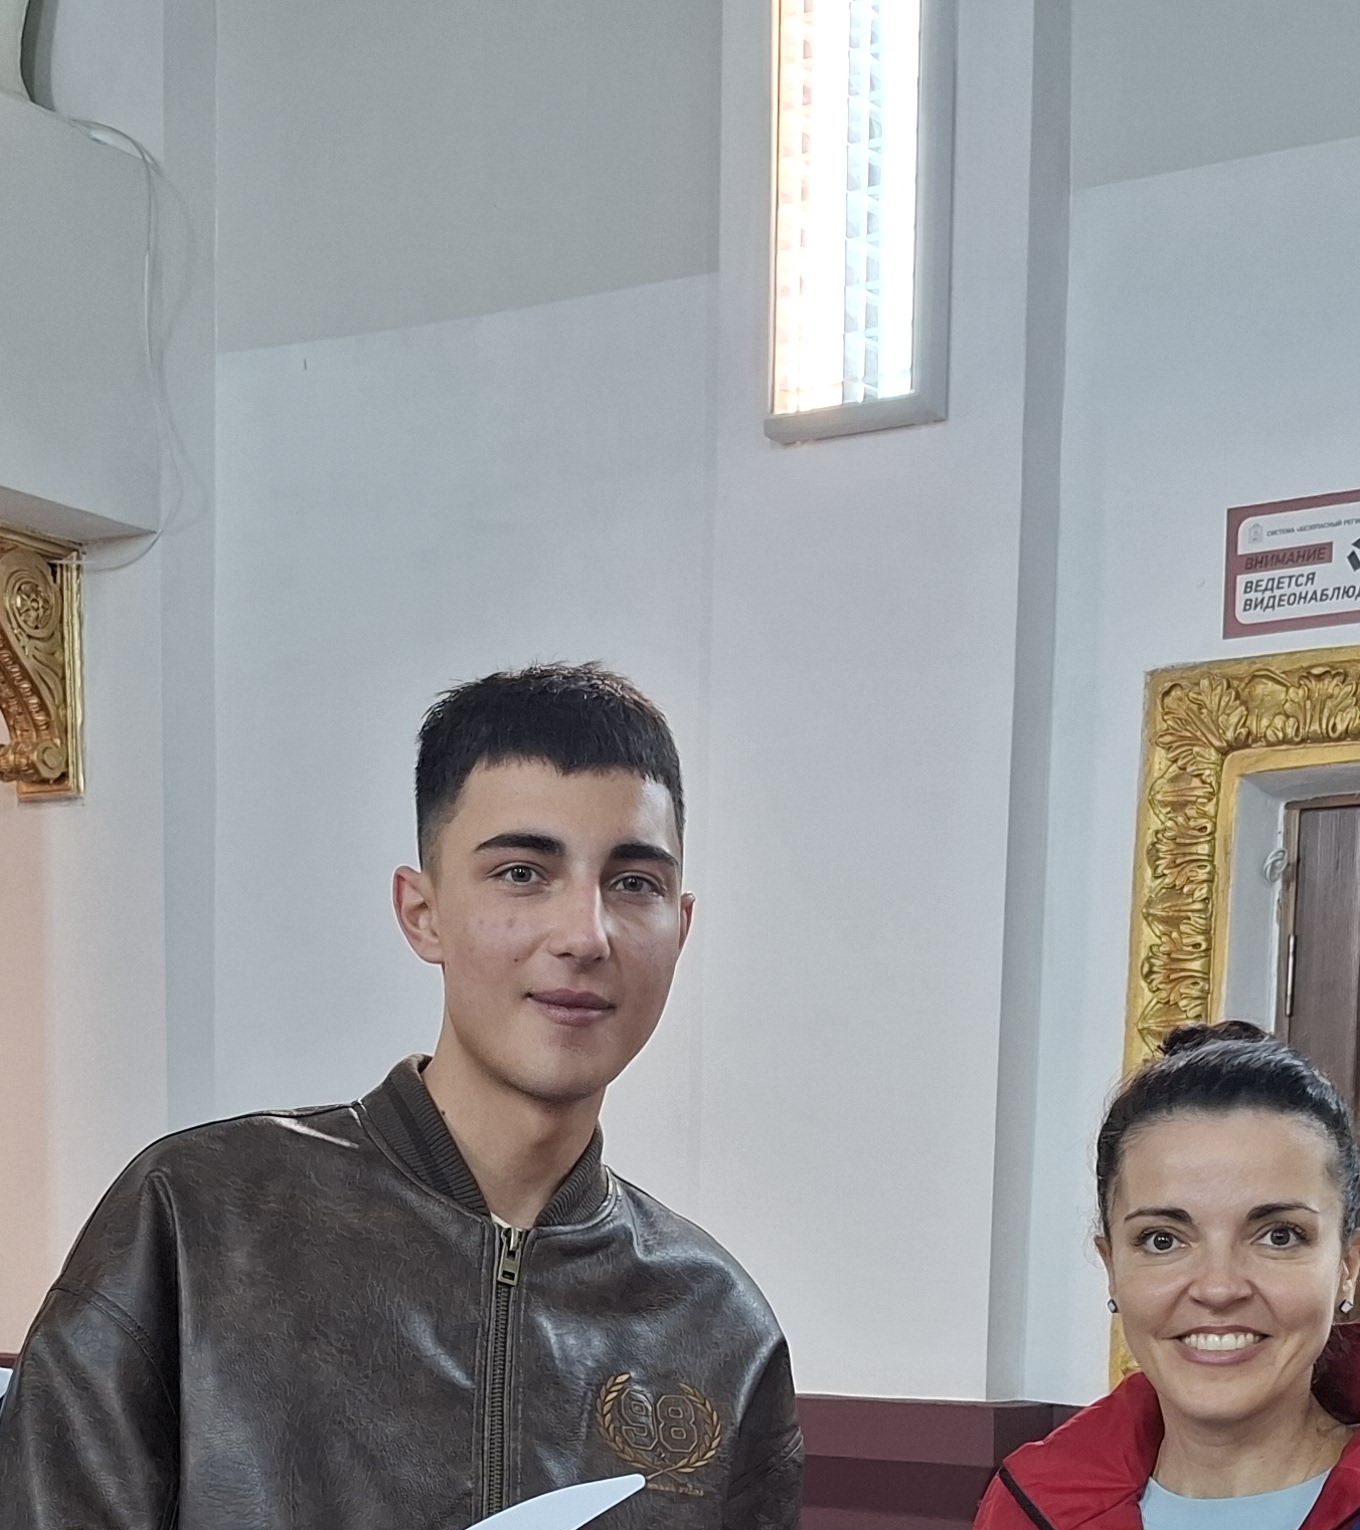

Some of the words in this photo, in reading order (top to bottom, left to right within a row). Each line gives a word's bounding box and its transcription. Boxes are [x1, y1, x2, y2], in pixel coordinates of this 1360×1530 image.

[1267, 526, 1295, 537] СИСТЕМА
[1244, 547, 1327, 571] ВНИМАНИЕ
[1243, 572, 1316, 595] ВЕДЕТСЯ
[620, 1387, 698, 1453] 98
